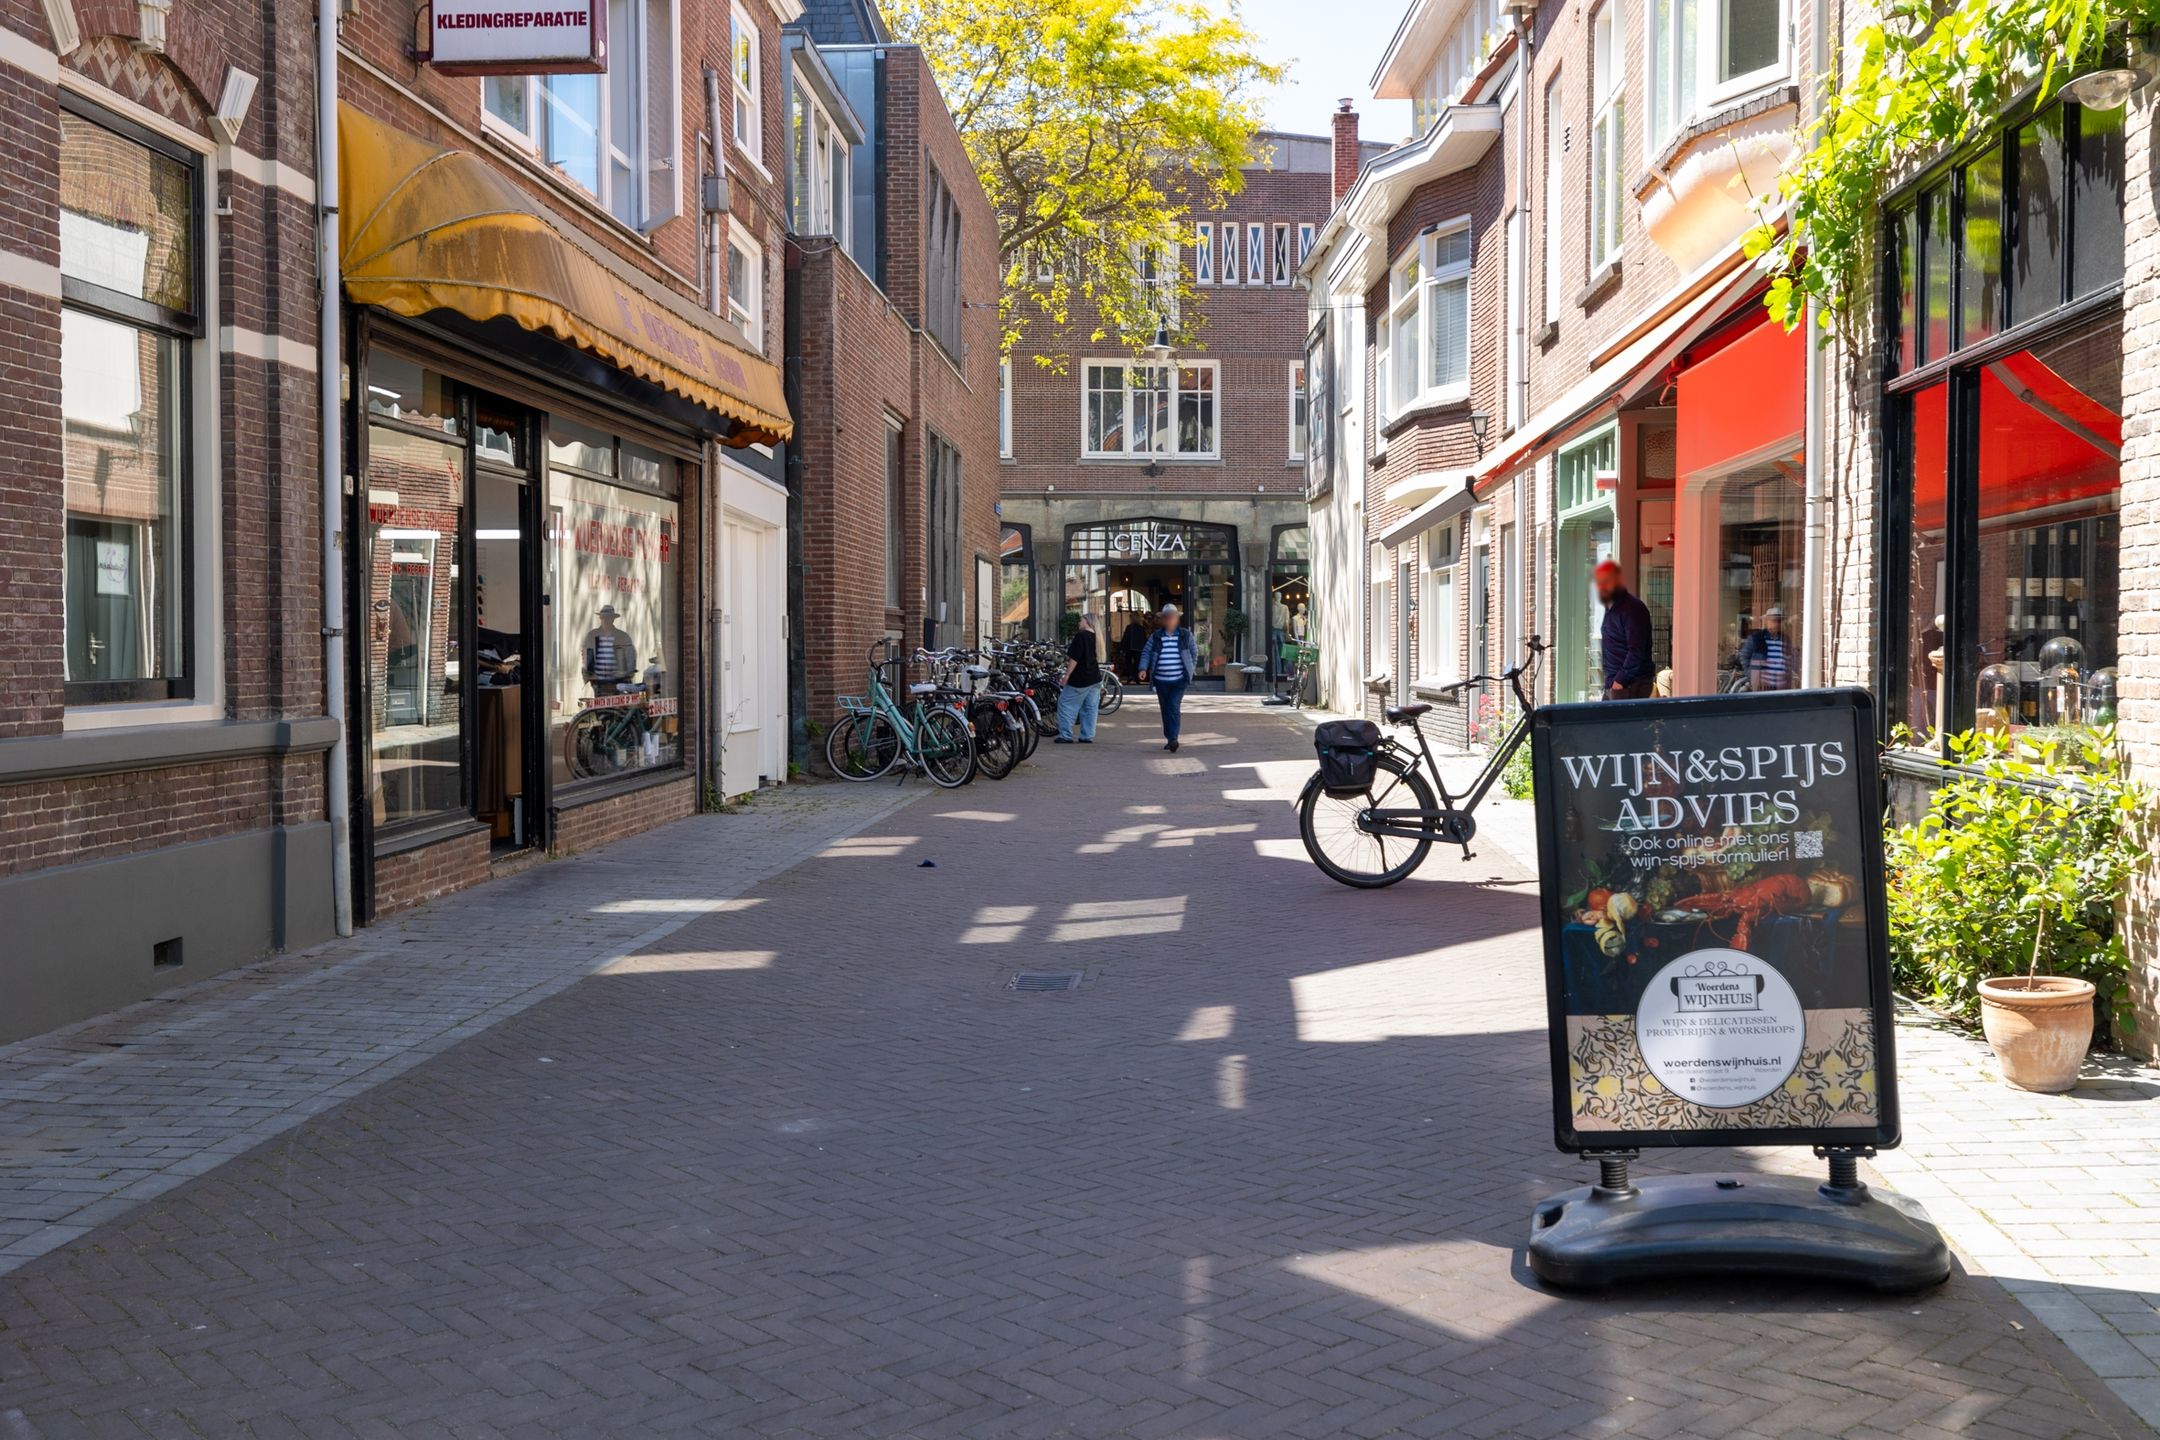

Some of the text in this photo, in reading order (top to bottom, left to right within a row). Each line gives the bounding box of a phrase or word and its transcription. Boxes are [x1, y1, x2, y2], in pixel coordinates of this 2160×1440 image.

[437, 11, 587, 29] KLEDINGREPARATIE
[1114, 522, 1187, 563] CENZA
[1561, 741, 1847, 796] WIJN&SPIJS
[1612, 790, 1800, 832] ADVIES
[1628, 833, 1789, 851] Ook online met ons
[1630, 847, 1789, 871] wijn-spijs formulier!
[1695, 982, 1740, 992] Woerdens
[1684, 993, 1753, 1008] WIJNHUIS
[1662, 1016, 1777, 1027] WIJN & DELICATESSEN
[1646, 1025, 1796, 1038] PROEVERIJEN & WORKSHOPS
[1663, 1056, 1783, 1069] woerdenswijnhuis.nl
